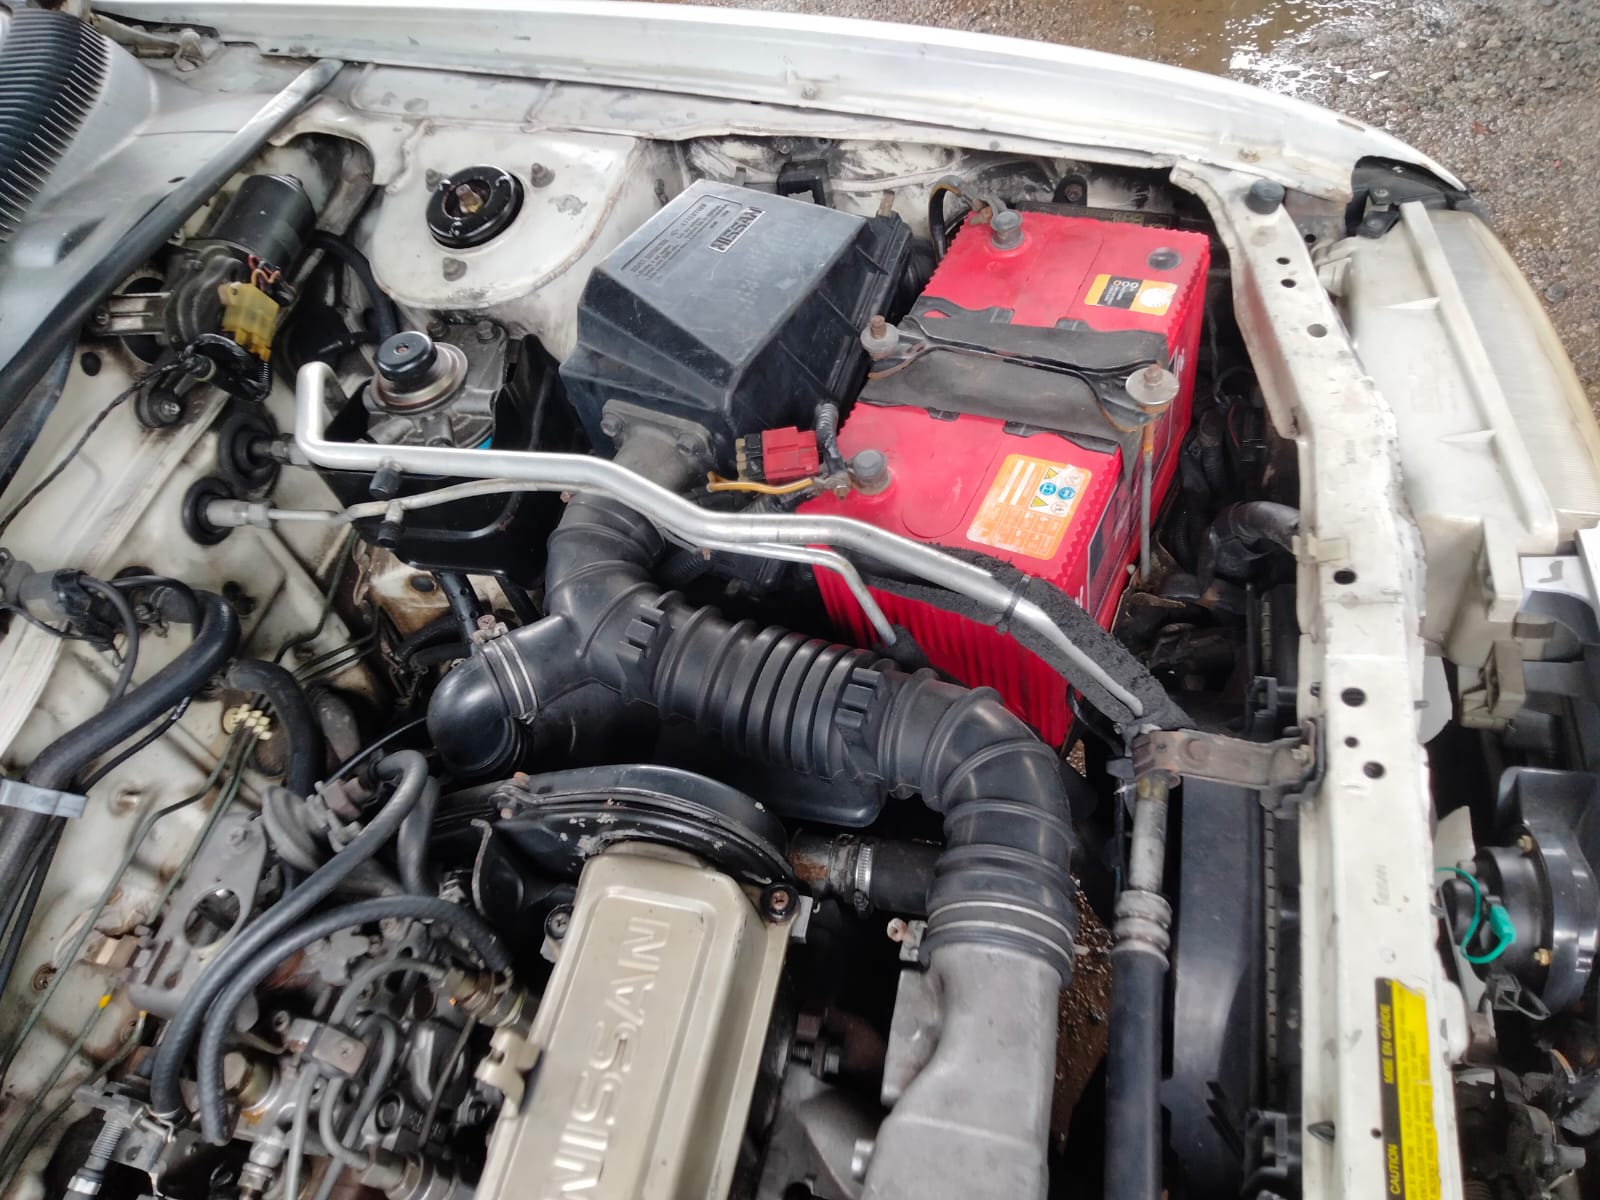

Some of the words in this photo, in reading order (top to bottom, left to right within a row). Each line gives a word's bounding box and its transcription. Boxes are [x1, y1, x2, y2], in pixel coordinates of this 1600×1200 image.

[709, 206, 764, 251] NISSAN
[1379, 1004, 1393, 1040] GARDE
[543, 916, 670, 1200] NISSAN
[1381, 1040, 1394, 1057] EN
[1387, 1143, 1401, 1195] CAUTION
